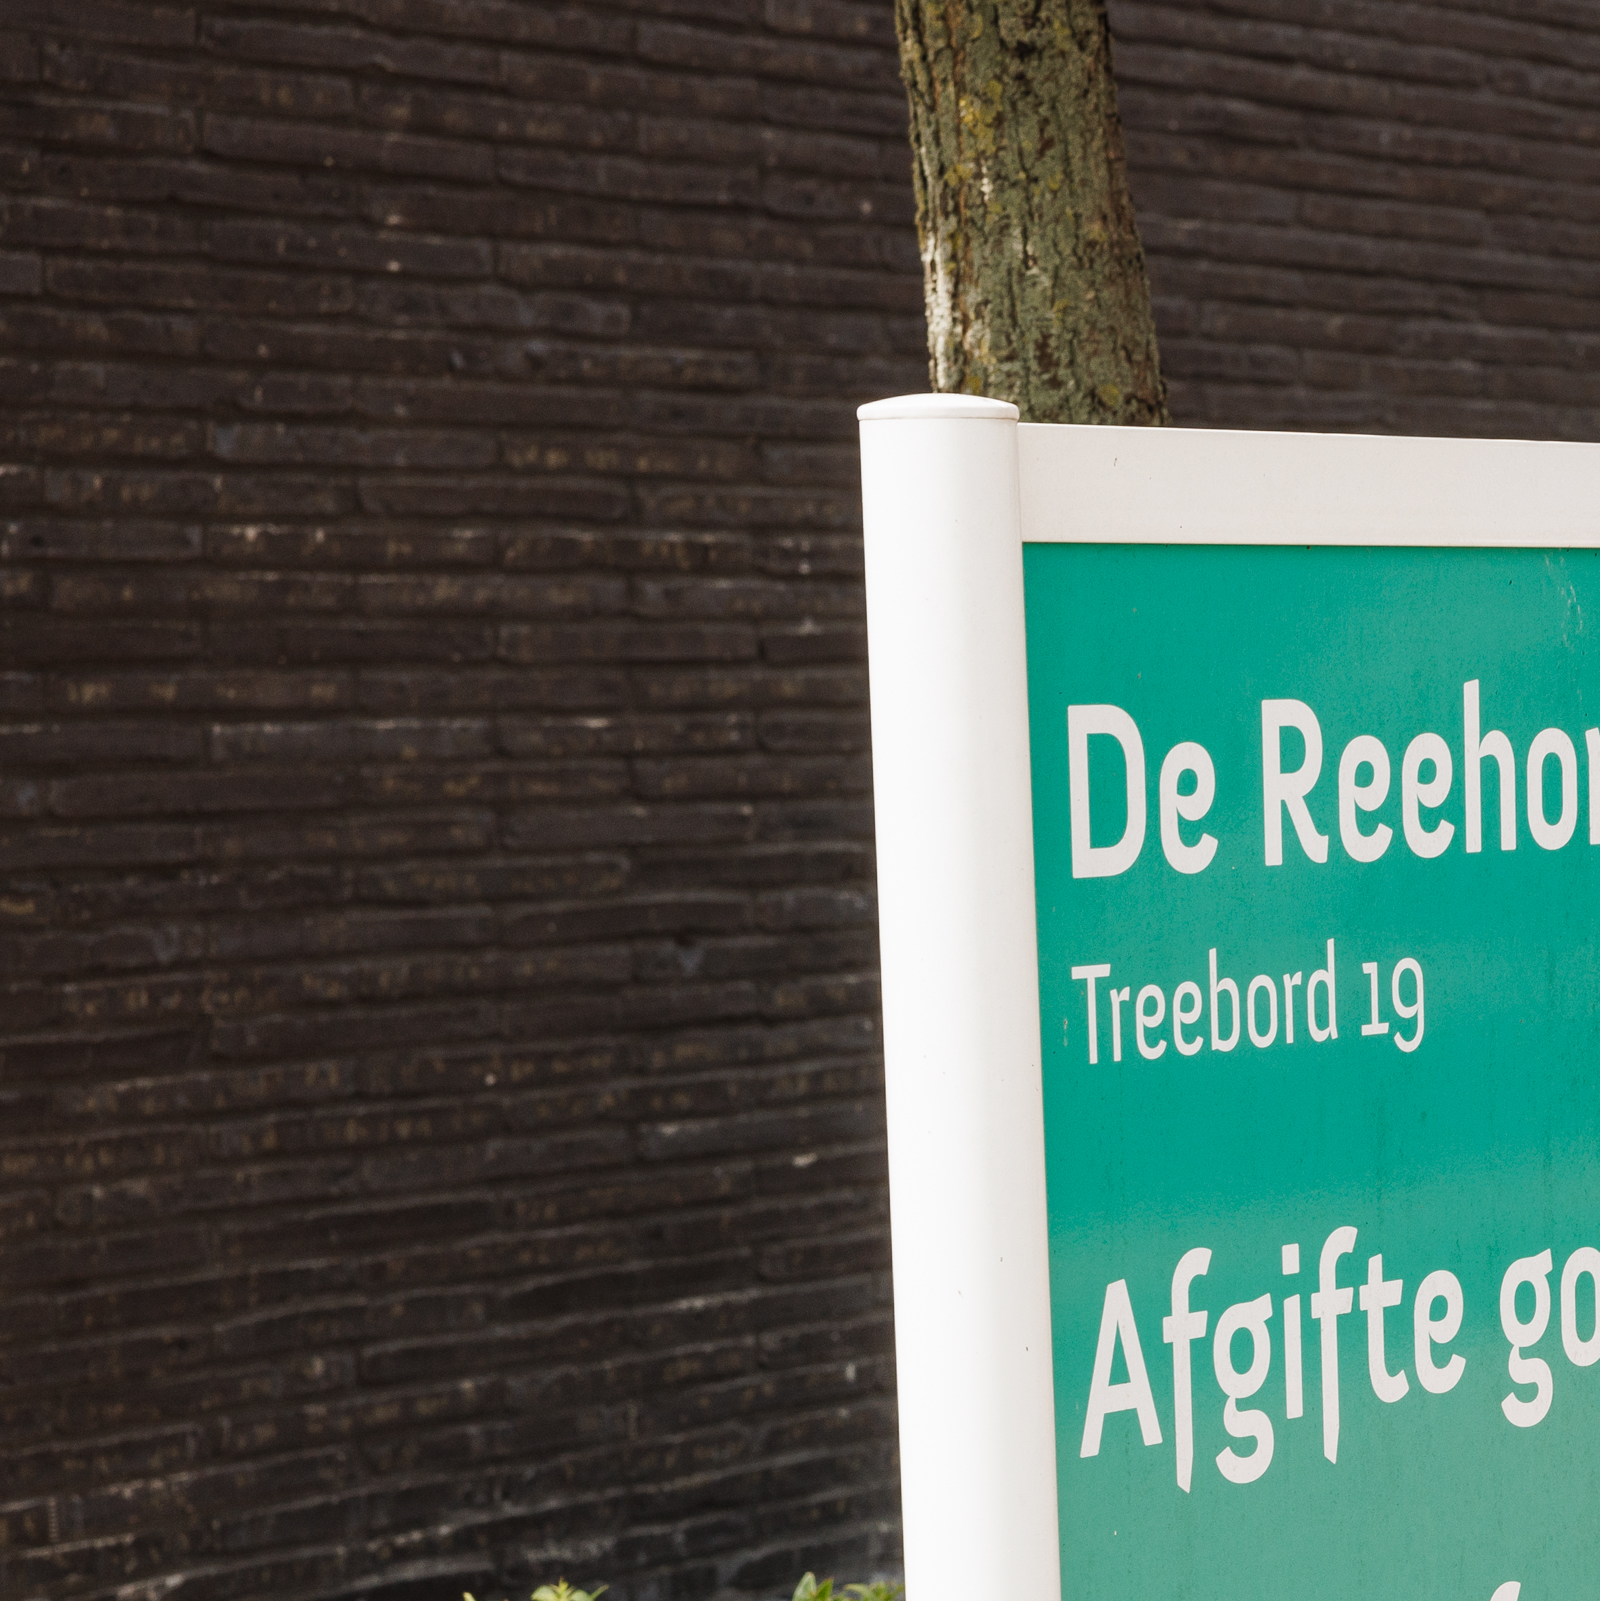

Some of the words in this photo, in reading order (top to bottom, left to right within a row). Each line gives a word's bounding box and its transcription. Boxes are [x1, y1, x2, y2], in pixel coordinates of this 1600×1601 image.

[1067, 704, 1219, 879] De
[1071, 938, 1338, 1065] Treebord
[1361, 957, 1425, 1053] 19
[1079, 1225, 1467, 1494] Afgifte
